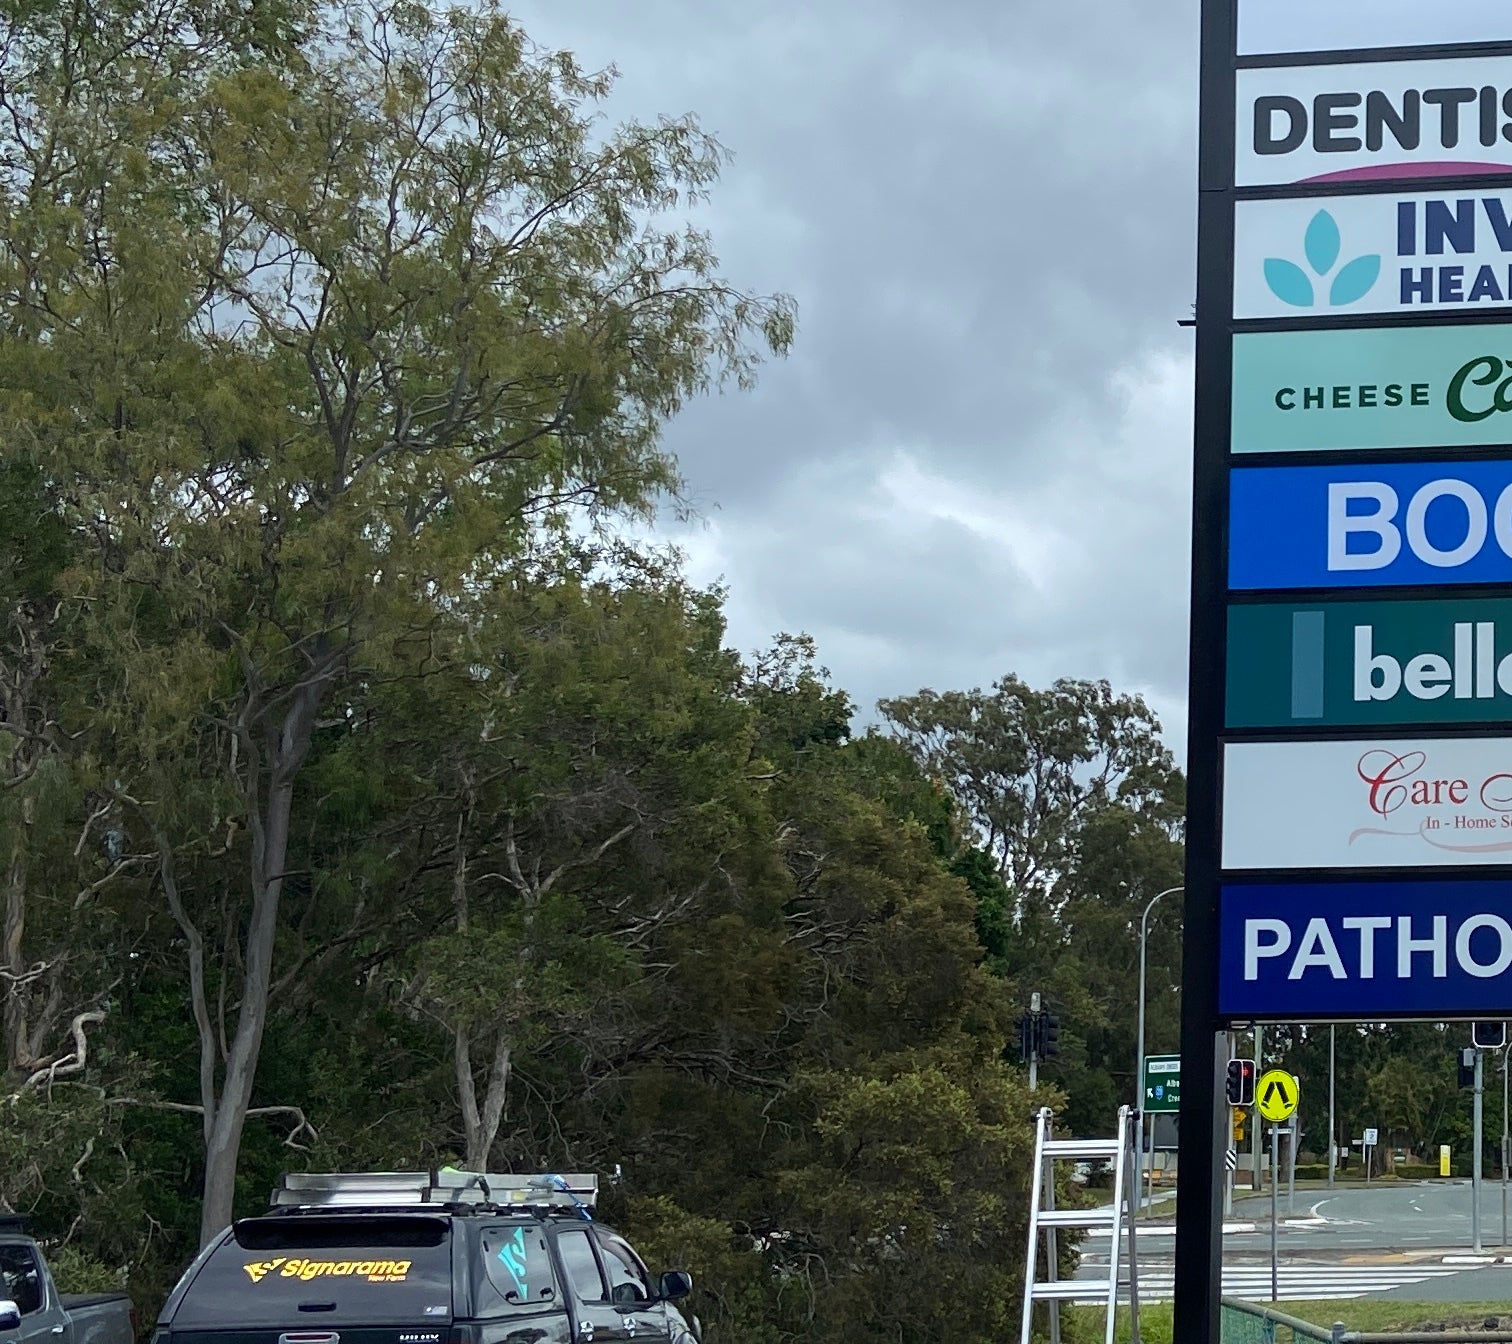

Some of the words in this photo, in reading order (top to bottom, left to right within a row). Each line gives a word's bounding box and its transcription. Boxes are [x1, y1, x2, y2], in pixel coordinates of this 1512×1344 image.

[1274, 382, 1430, 411] CHEESE
[1357, 749, 1469, 820] Care
[1427, 816, 1440, 829] In
[1454, 816, 1496, 829] Home
[280, 1259, 412, 1281] Signarama
